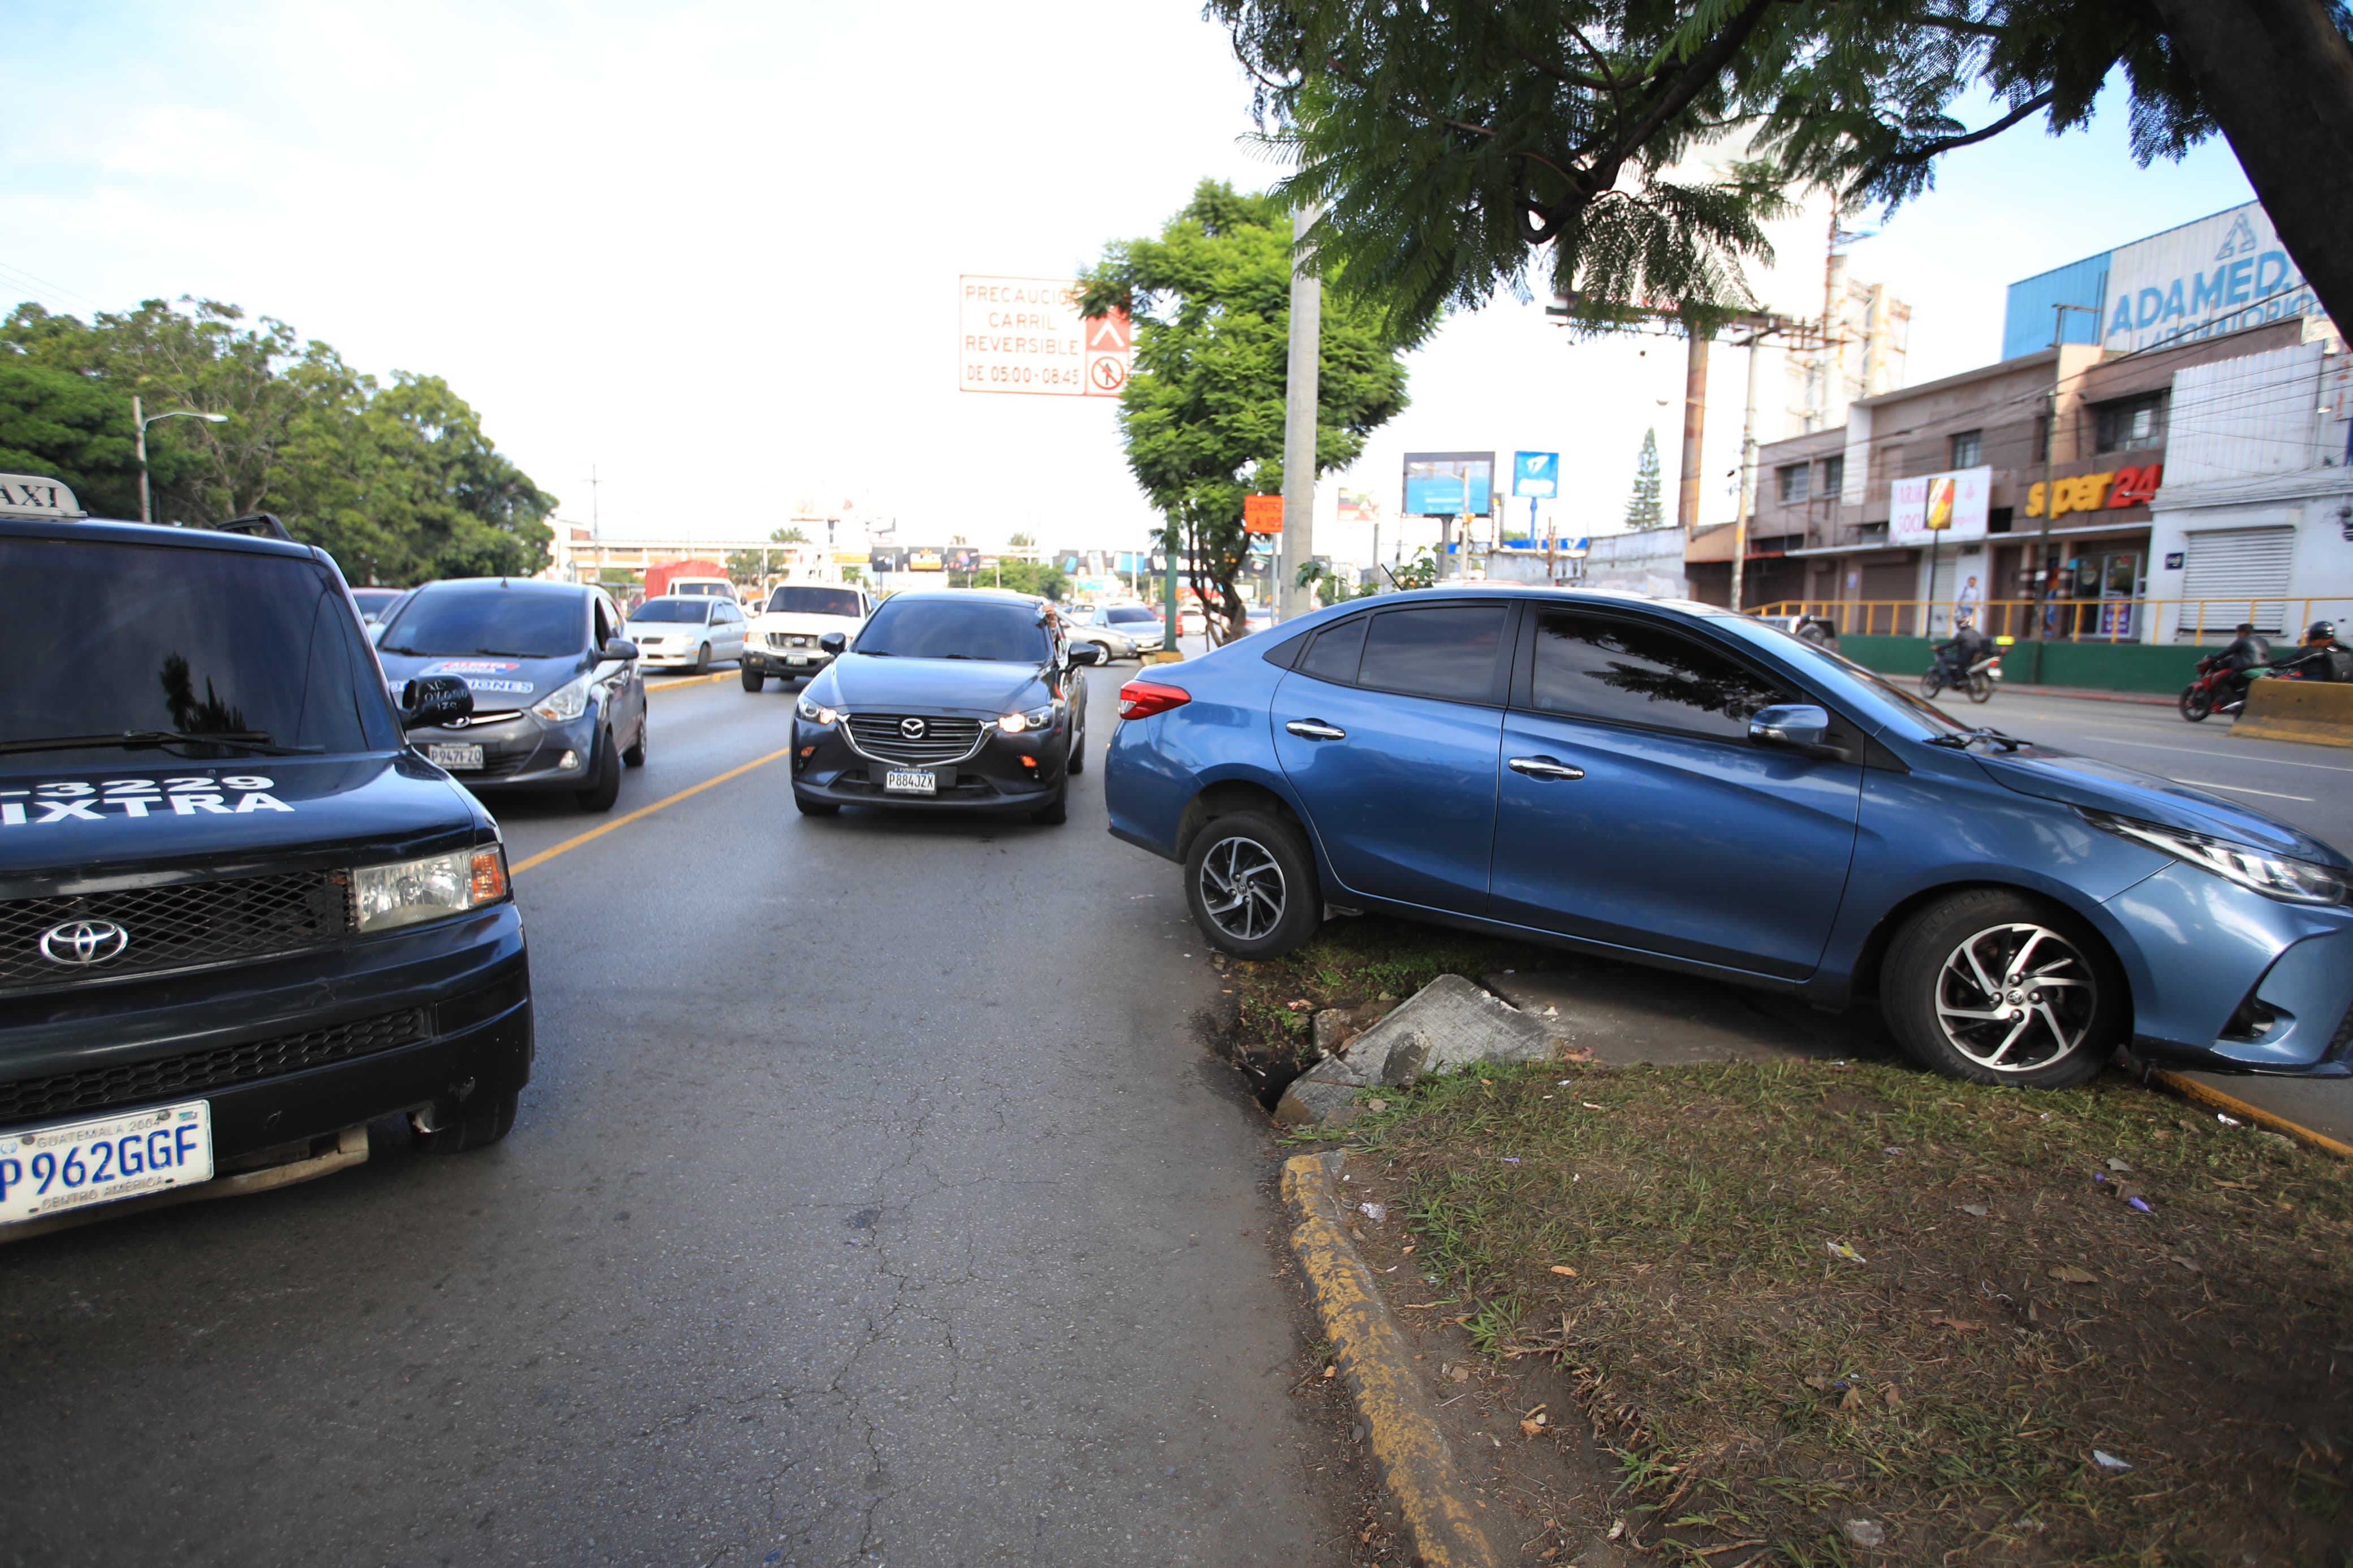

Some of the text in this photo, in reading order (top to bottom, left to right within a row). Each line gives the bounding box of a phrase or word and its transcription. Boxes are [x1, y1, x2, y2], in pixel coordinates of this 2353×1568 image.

[2108, 250, 2304, 337] ADAMED
[988, 312, 1057, 330] CARRIL
[966, 335, 1079, 355] REVERSIBLE
[967, 365, 984, 381] DE
[990, 366, 1032, 383] 05:00
[1042, 368, 1079, 385] 08:45
[0, 483, 59, 508] AXI
[889, 774, 933, 788] P884JZX
[37, 1117, 161, 1149] GUATEMALA 2004
[42, 1189, 98, 1210] CENTRO
